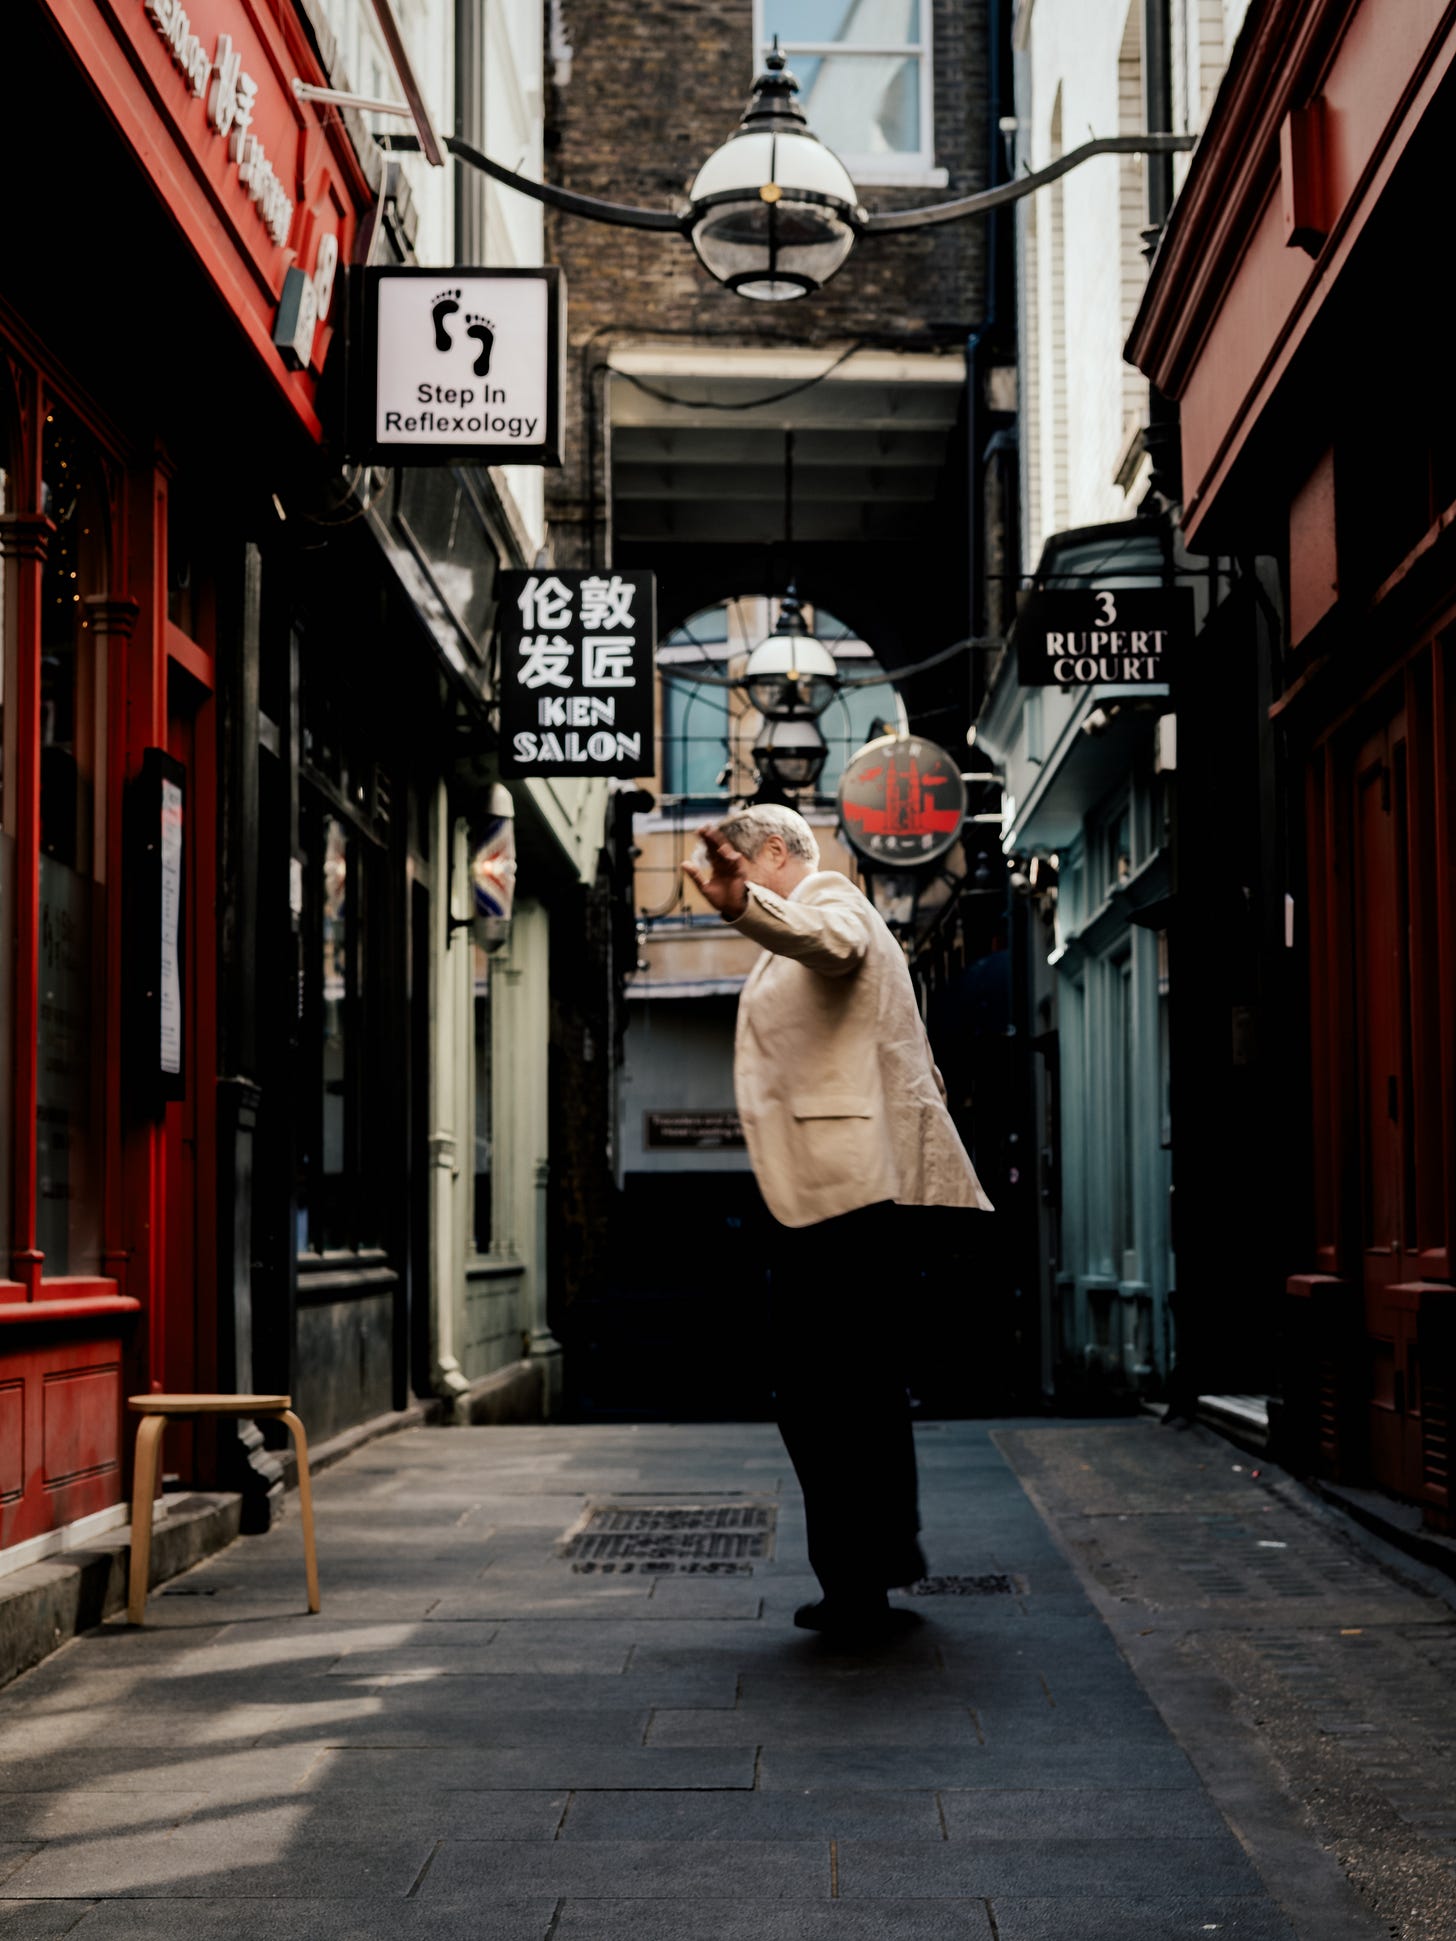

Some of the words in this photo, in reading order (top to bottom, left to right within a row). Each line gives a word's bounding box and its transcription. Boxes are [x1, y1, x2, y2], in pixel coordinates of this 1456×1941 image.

[417, 383, 475, 408] Step
[485, 384, 506, 404] In
[385, 411, 538, 438] Reflexology
[517, 575, 637, 631] 伦敦
[1094, 591, 1117, 627] 3
[1046, 630, 1168, 656] RUPERT
[517, 635, 637, 689] 发匠
[1053, 656, 1160, 682] COURT
[538, 696, 616, 727] KEN
[513, 731, 642, 762] SALON
